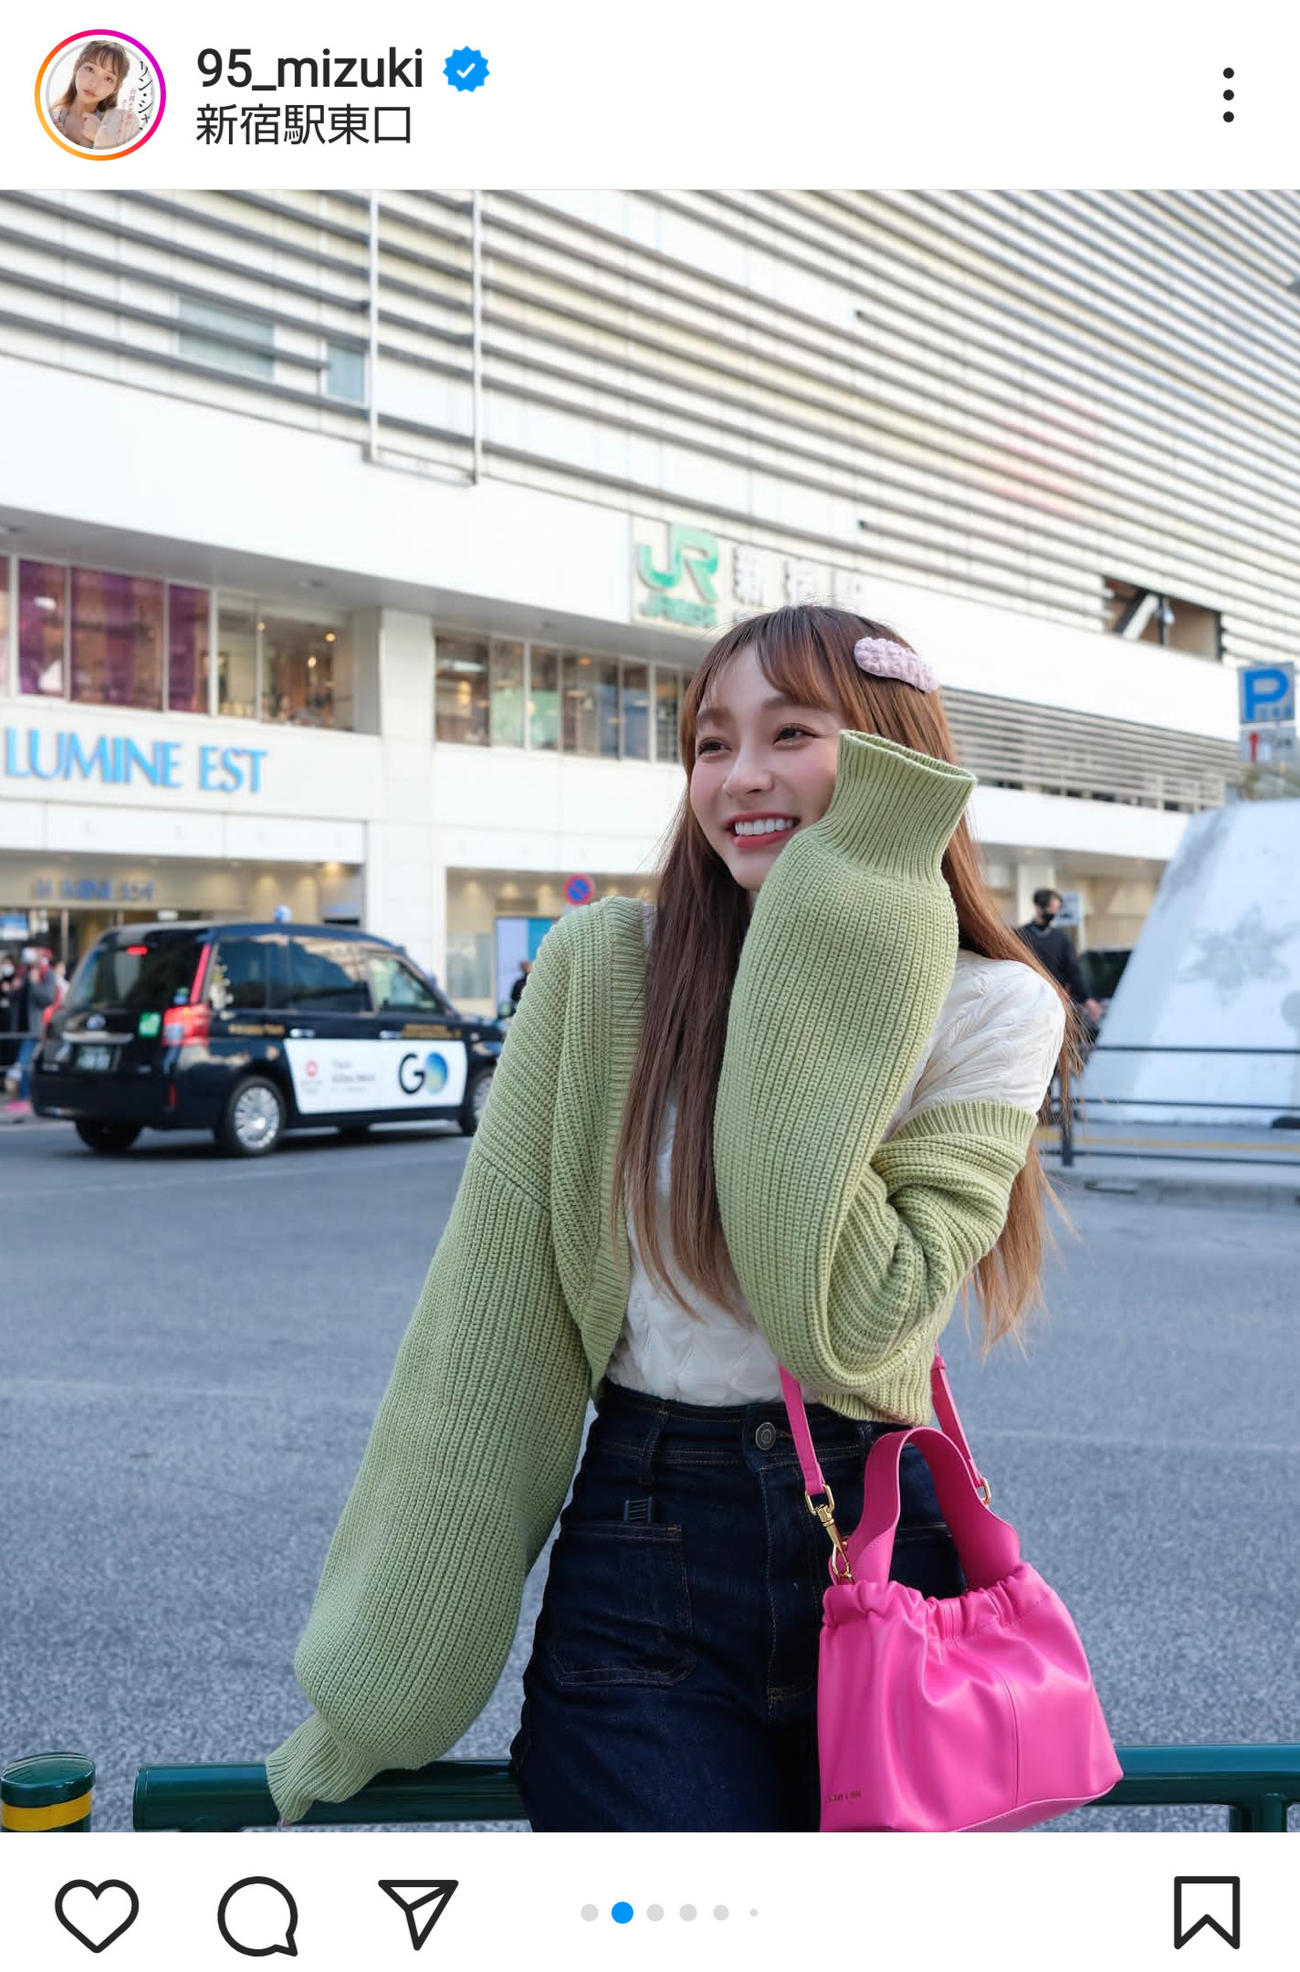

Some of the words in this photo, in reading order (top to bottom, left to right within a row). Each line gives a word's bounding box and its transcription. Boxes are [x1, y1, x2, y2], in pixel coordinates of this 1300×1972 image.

[637, 523, 719, 604] JR
[1244, 668, 1289, 722] P
[4, 726, 182, 788] LUMINE
[199, 744, 268, 793] EST
